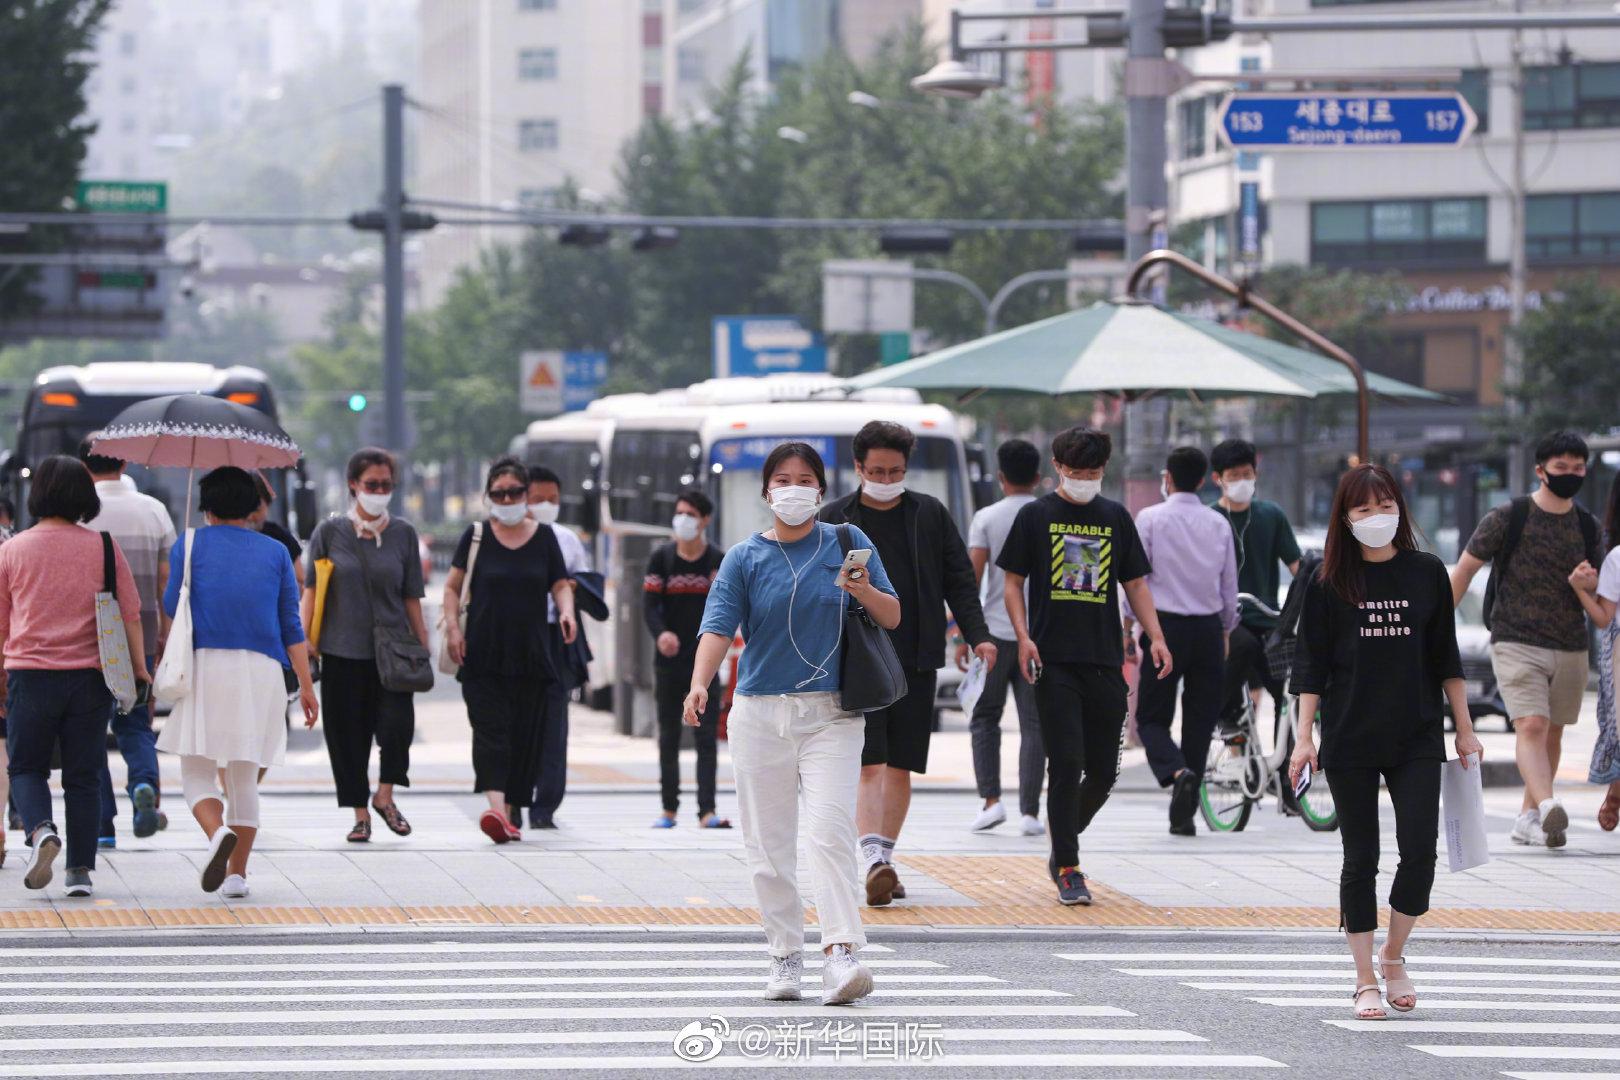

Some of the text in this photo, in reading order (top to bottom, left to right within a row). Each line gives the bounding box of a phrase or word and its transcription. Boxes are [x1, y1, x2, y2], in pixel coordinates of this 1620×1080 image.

[1295, 99, 1394, 126] 세종대로
[1425, 110, 1459, 131] 157
[1230, 111, 1264, 132] 153
[1049, 523, 1112, 537] BEARABLE
[1369, 613, 1401, 622] de la
[1360, 626, 1411, 636] lumière
